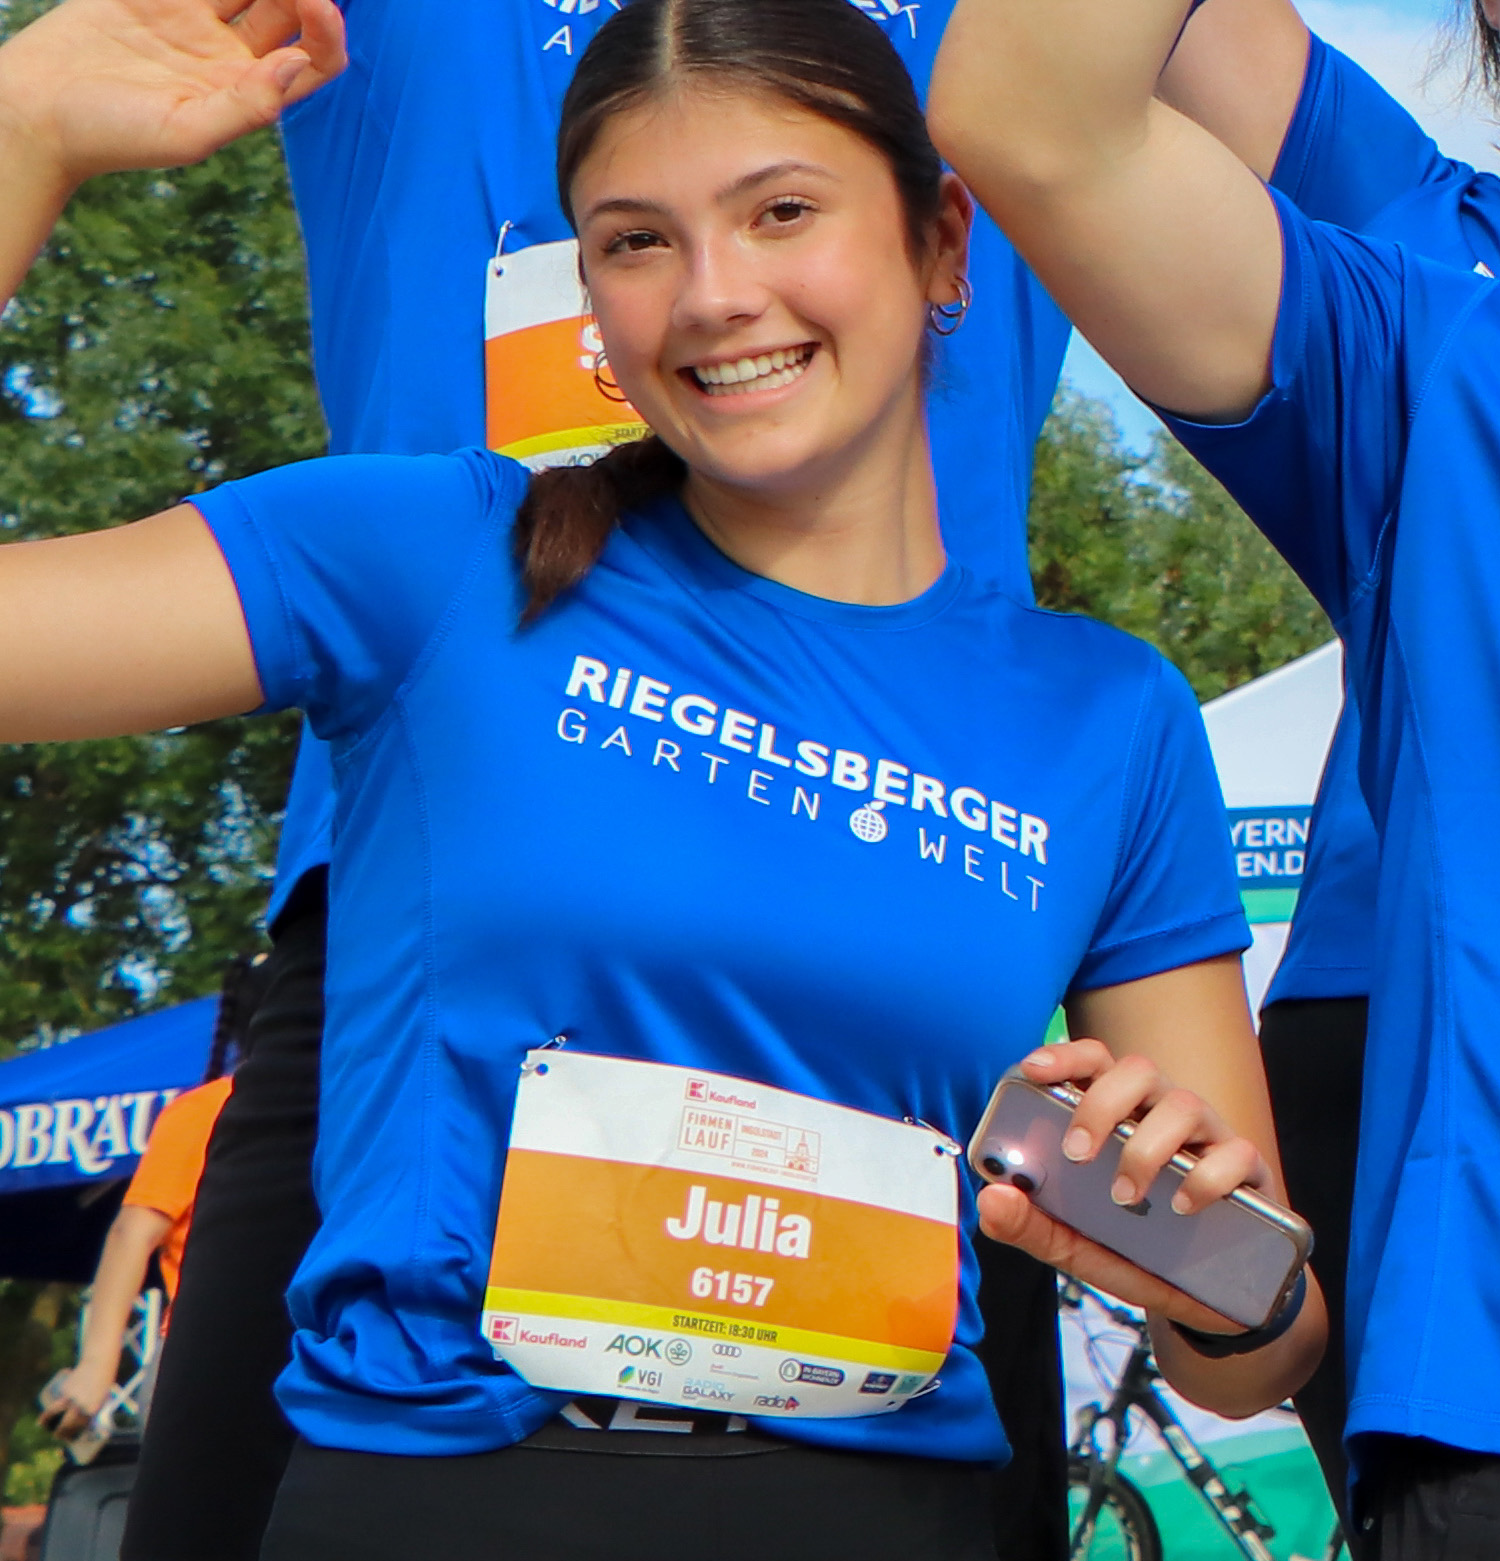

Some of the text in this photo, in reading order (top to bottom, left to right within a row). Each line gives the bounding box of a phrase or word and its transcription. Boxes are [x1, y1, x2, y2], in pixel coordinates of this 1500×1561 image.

[557, 707, 1045, 913] GARTEN WELT
[709, 1091, 757, 1109] Kaufland
[687, 1112, 732, 1130] FIRMEN
[684, 1127, 730, 1150] LAUF
[666, 1186, 812, 1259] Julia
[691, 1267, 774, 1307] 6157
[673, 1315, 778, 1343] STARTZEIT: 18:30 UHR
[519, 1330, 587, 1349] Kaufland
[604, 1334, 665, 1359] AOK
[637, 1368, 662, 1387] VGI
[681, 1385, 736, 1402] GALAXY
